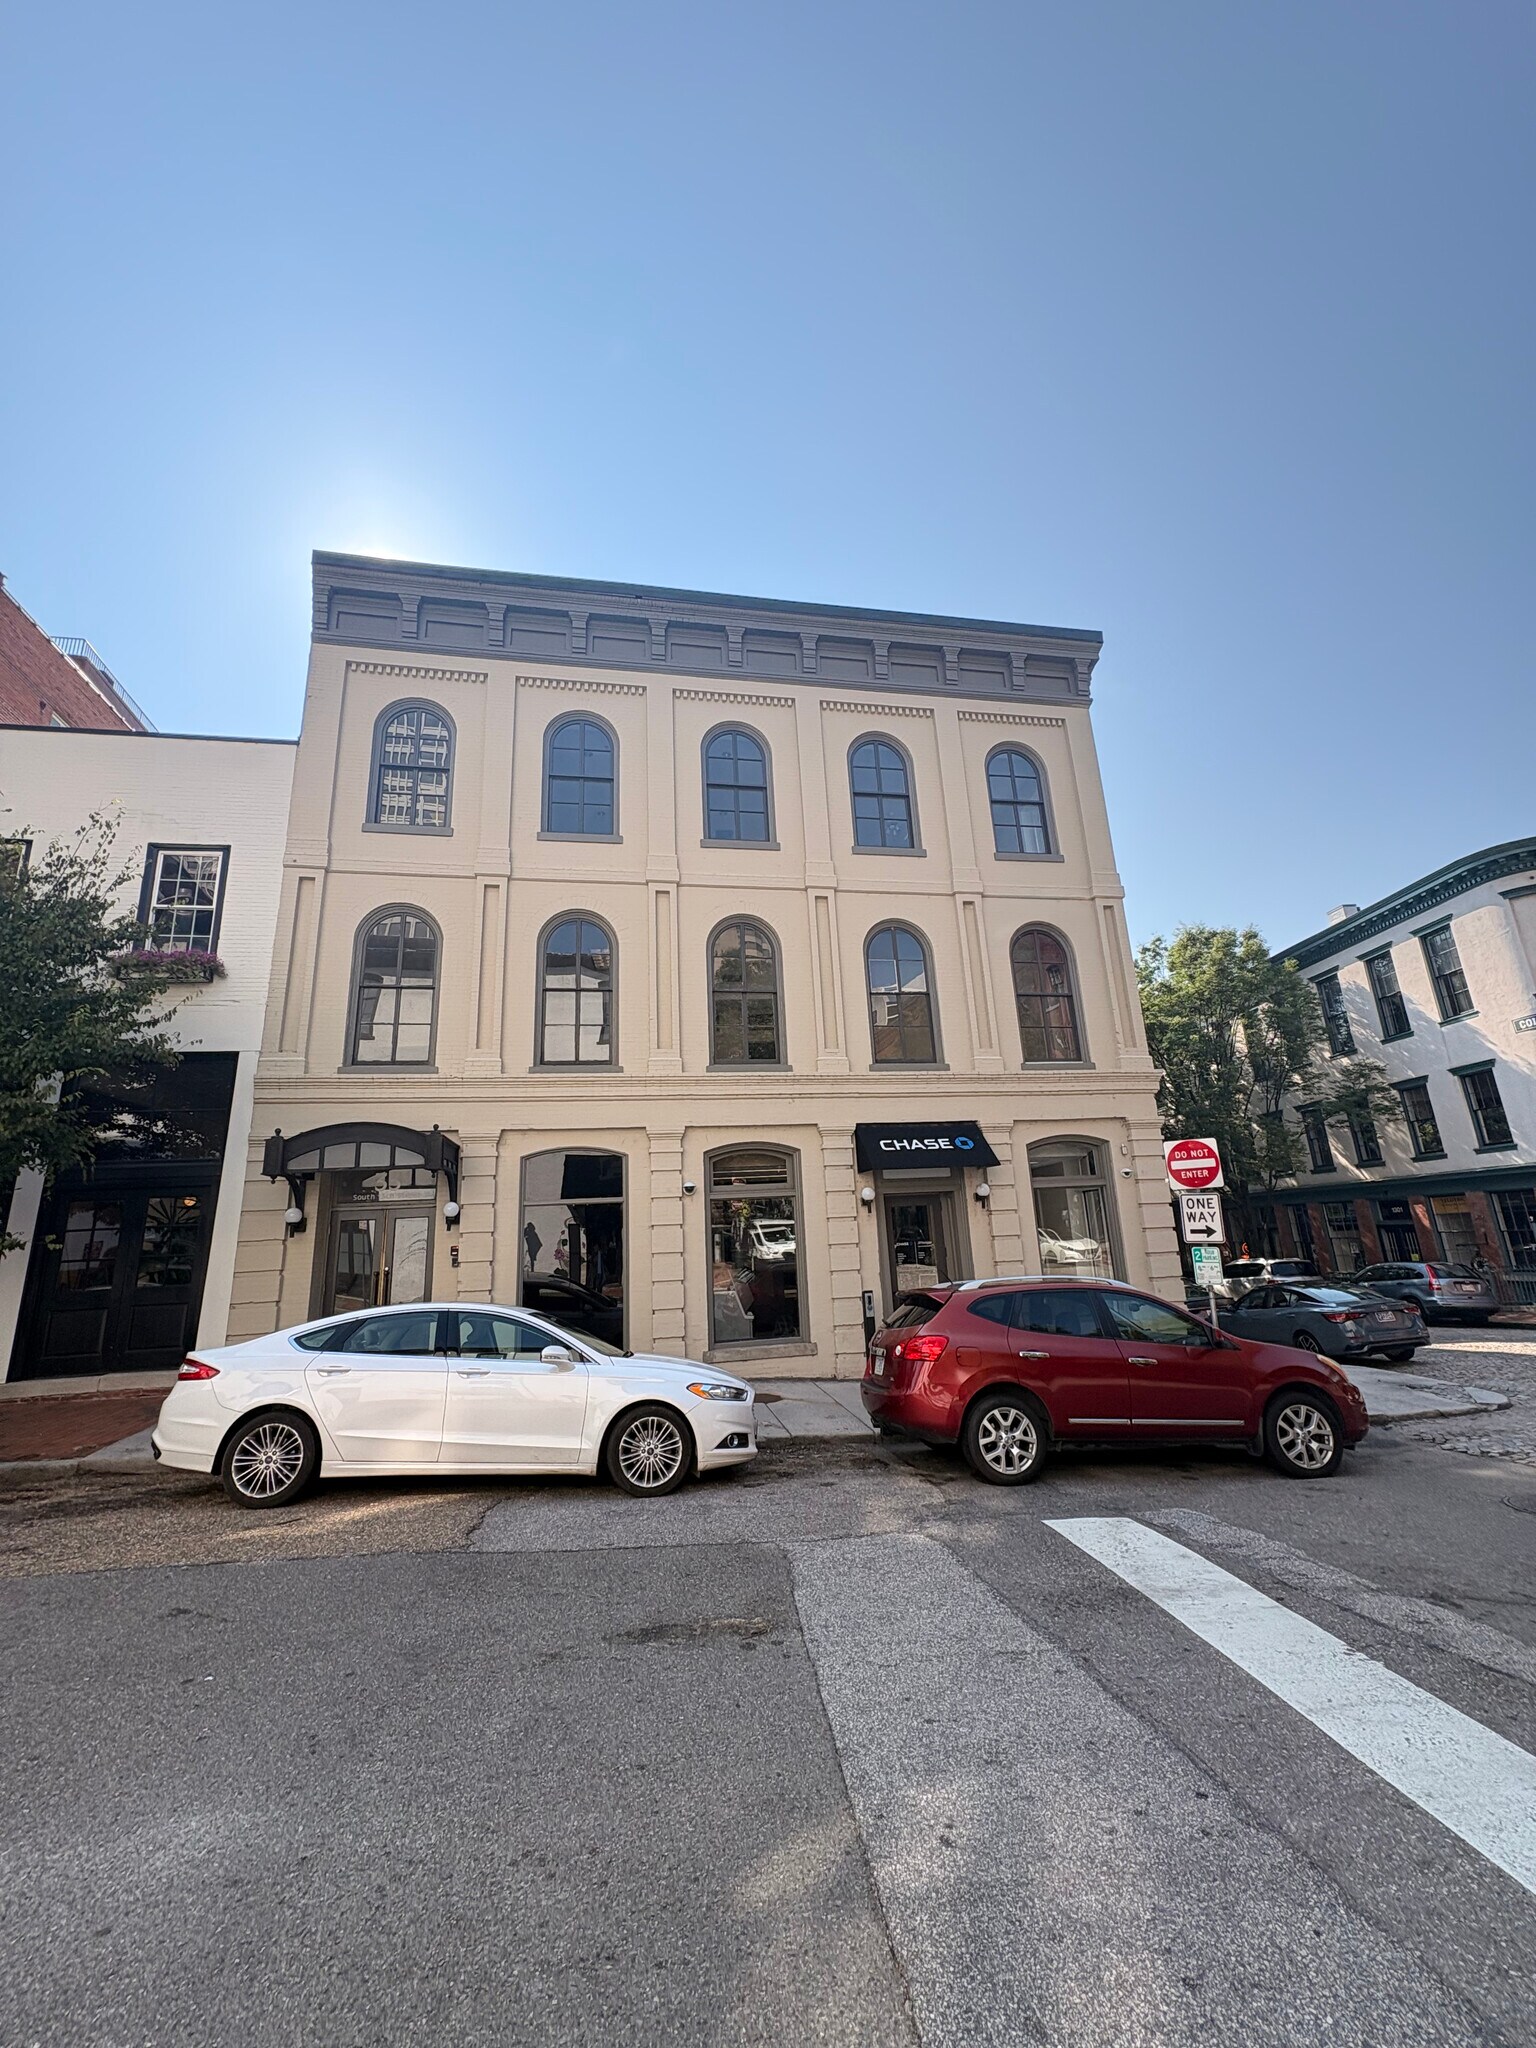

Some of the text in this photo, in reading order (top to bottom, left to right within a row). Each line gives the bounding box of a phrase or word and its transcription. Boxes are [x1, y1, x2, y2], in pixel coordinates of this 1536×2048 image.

[880, 1138, 954, 1151] CHASE
[1175, 1149, 1209, 1159] DO NOT
[1181, 1169, 1209, 1179] ENTER
[1186, 1198, 1215, 1210] ONE
[1186, 1211, 1217, 1223] WAY
[1194, 1250, 1202, 1261] 2
